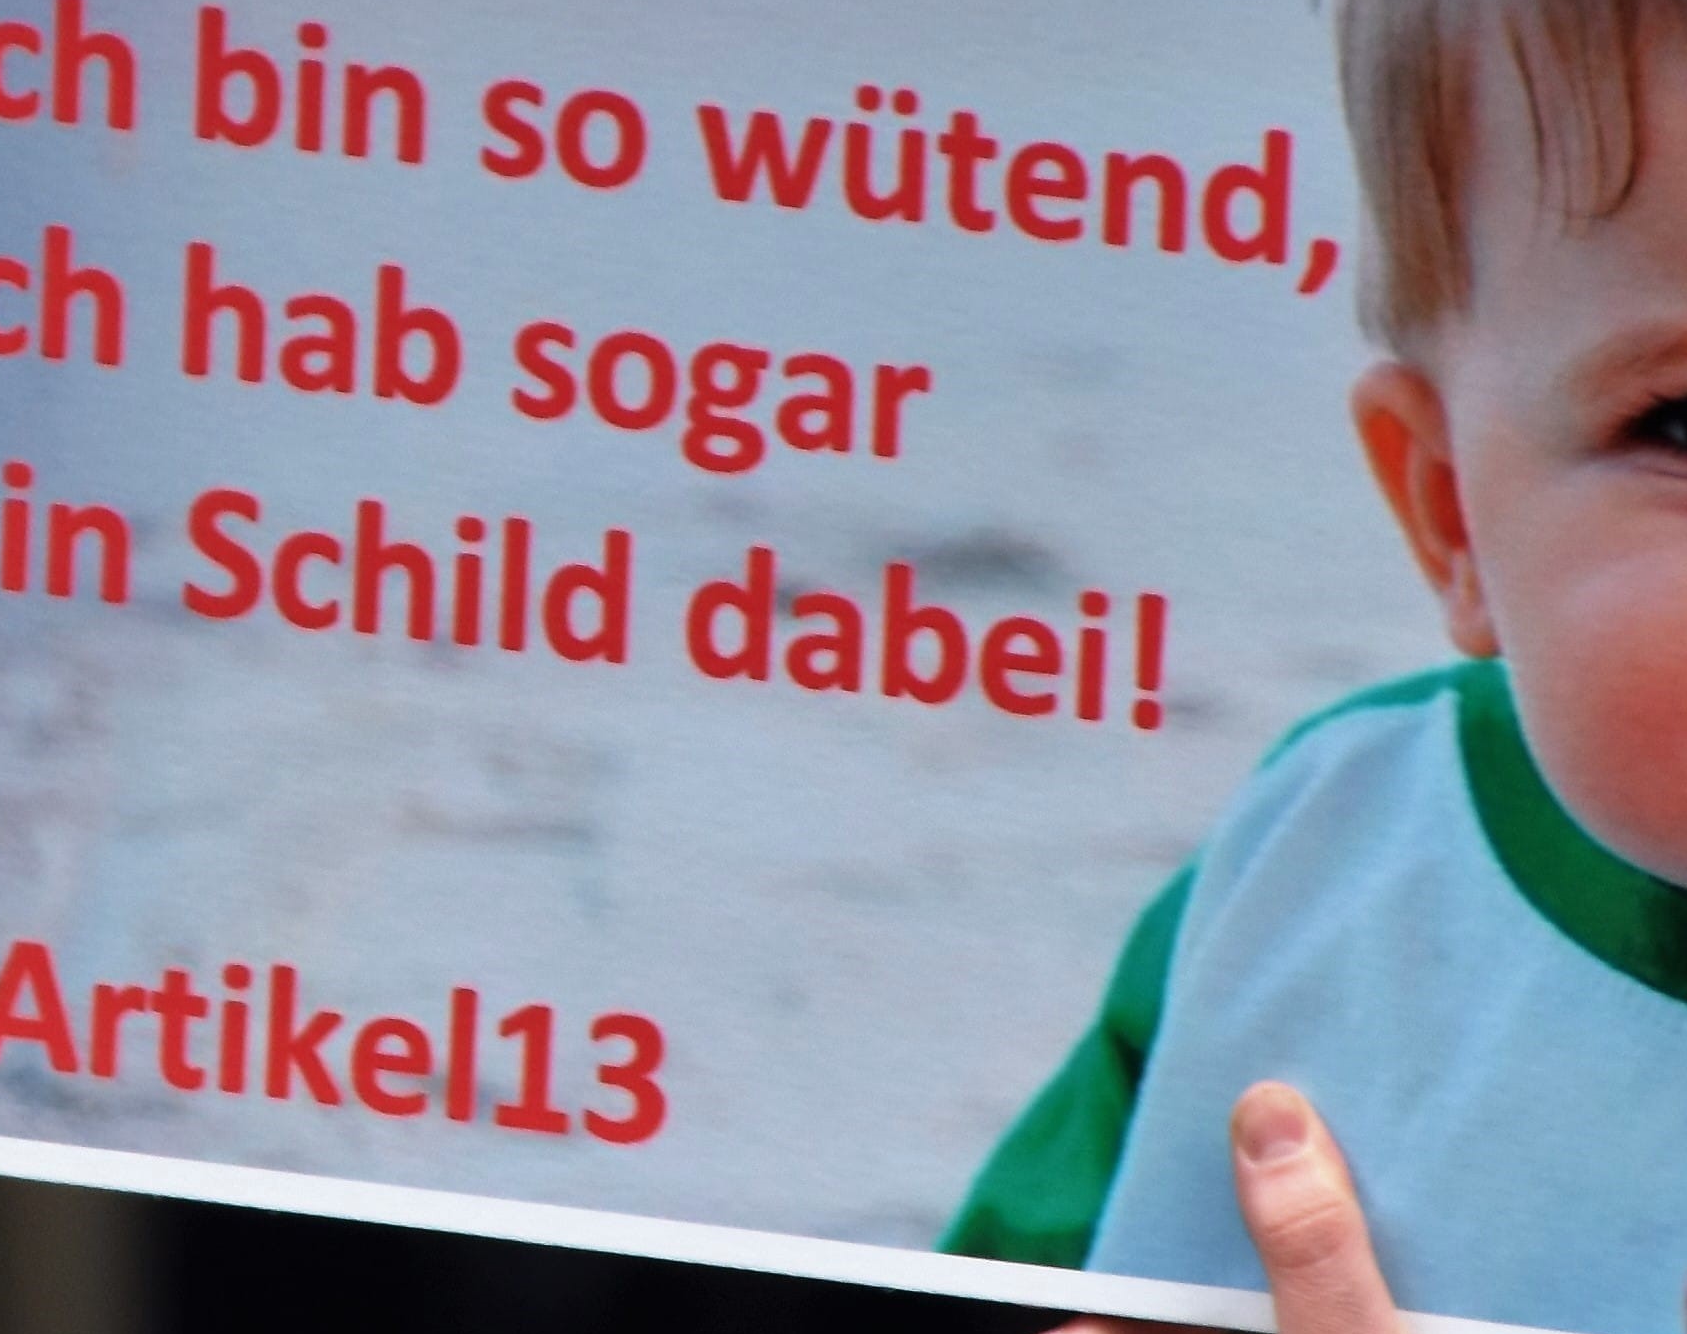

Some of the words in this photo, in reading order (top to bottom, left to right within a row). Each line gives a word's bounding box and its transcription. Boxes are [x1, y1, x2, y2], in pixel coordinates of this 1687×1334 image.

[193, 3, 427, 167] bin
[480, 78, 648, 192] so
[697, 84, 1340, 297] wütend,
[181, 240, 464, 408] hab
[511, 319, 933, 477] sogar
[181, 486, 634, 667] Schild
[684, 544, 1172, 733] dabei!
